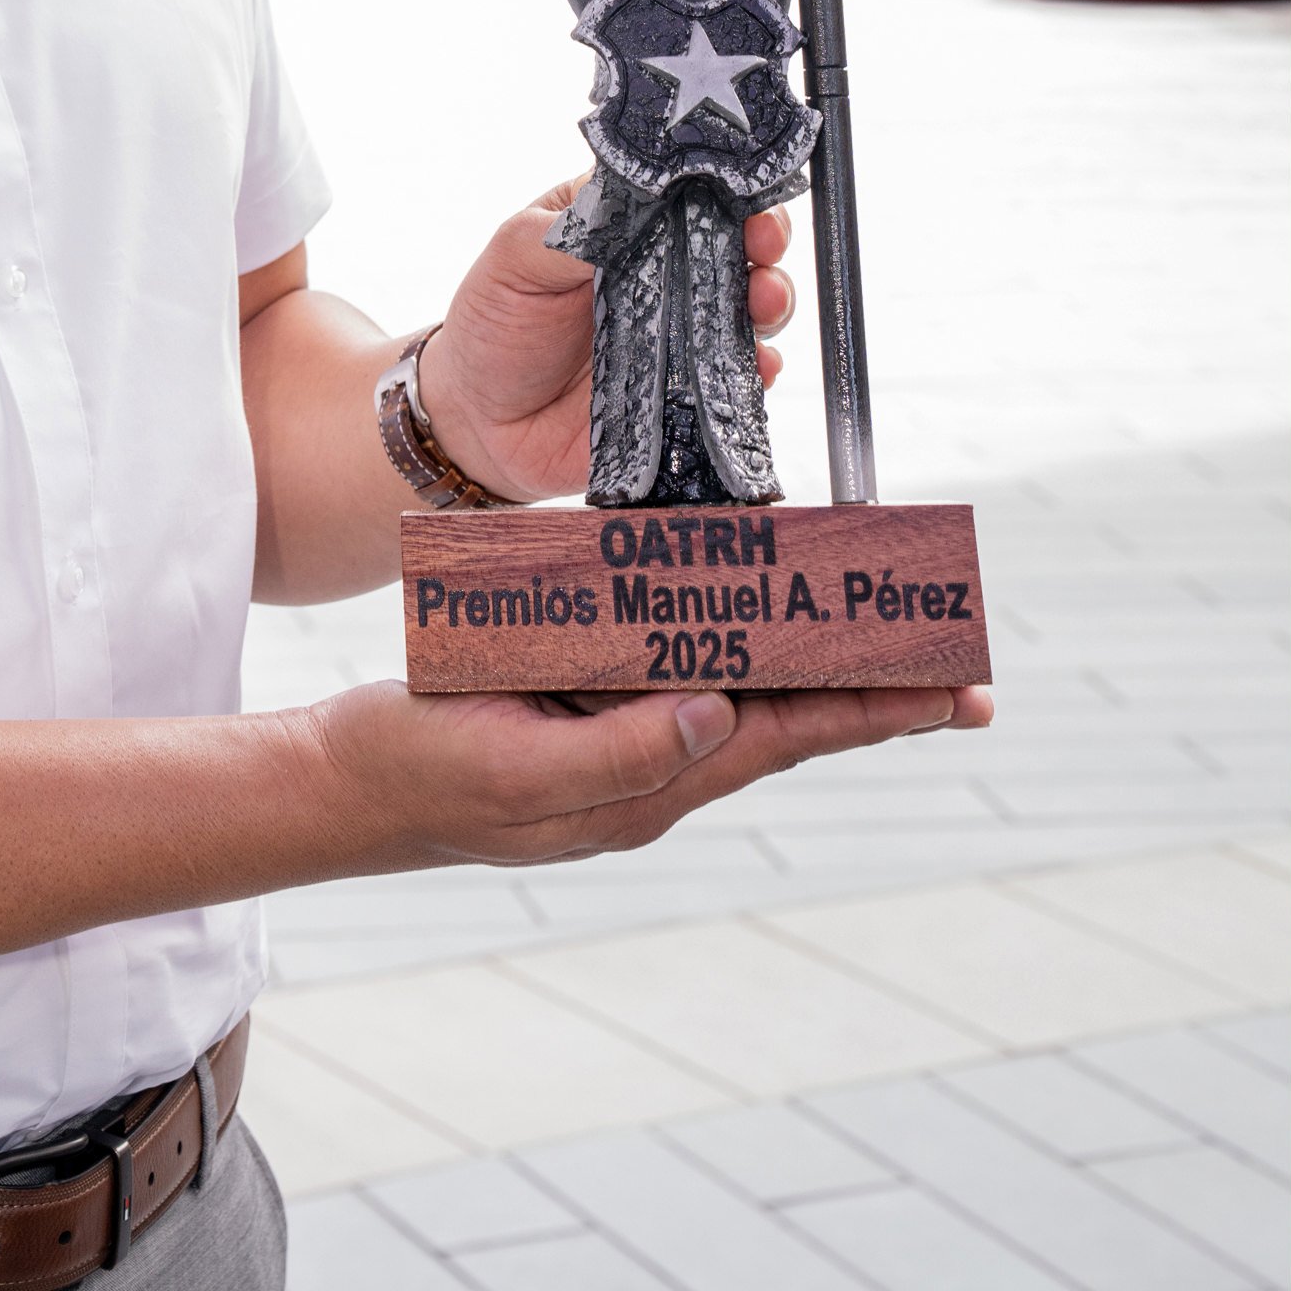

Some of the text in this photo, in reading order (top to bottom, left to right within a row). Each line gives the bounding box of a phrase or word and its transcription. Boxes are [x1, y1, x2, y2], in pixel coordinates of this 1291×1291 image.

[600, 517, 776, 569] OATRH
[416, 570, 972, 627] Premios Manuel A. Pérez
[645, 630, 751, 680] 2025
